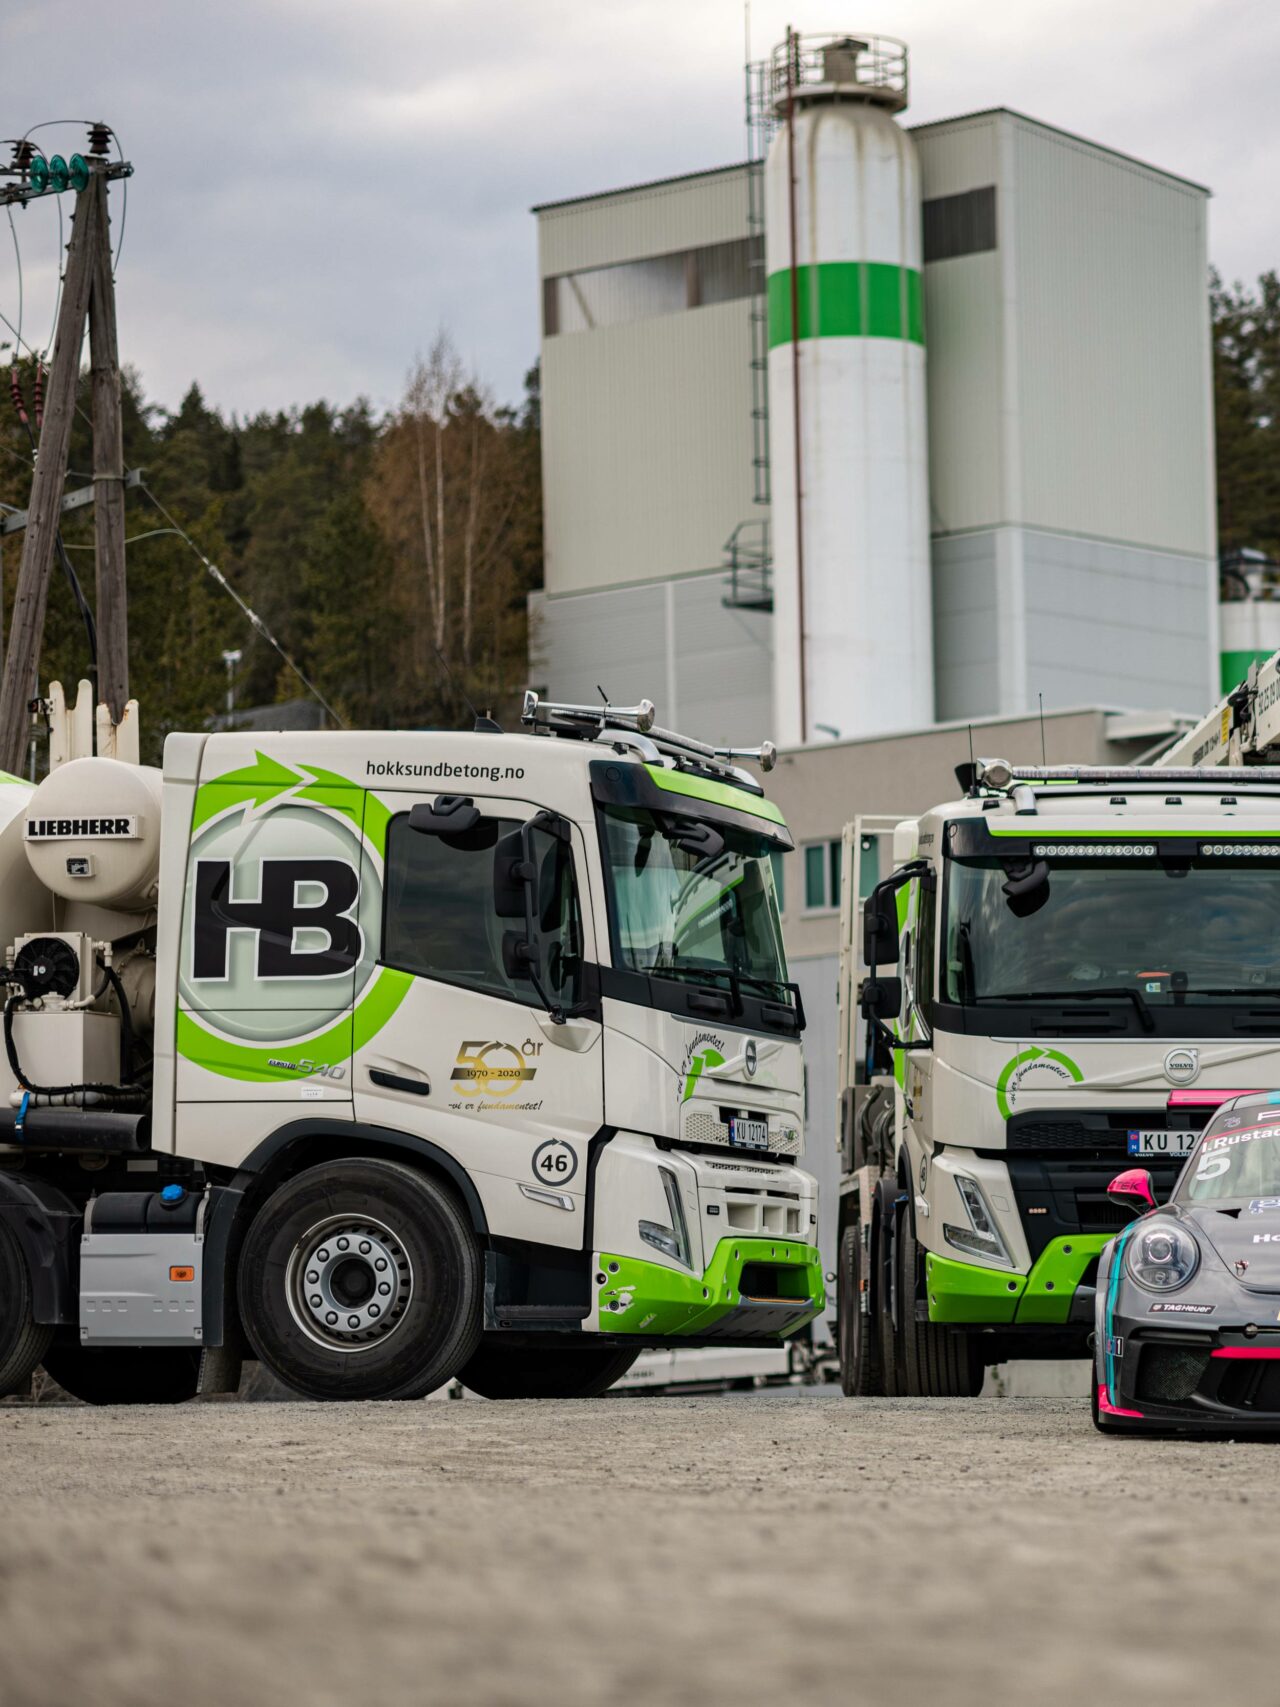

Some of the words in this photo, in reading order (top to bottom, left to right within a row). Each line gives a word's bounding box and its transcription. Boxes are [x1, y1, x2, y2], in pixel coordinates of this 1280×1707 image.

[366, 760, 525, 782] hokksundbetong.no
[28, 818, 130, 837] LIEBHERR
[193, 856, 364, 982] HB
[521, 1038, 543, 1056] år
[298, 1059, 346, 1080] 540
[467, 1070, 488, 1079] 1970
[477, 1100, 543, 1112] fundamentet!
[737, 1121, 745, 1139] KU
[749, 1123, 765, 1142] 12174
[1144, 1134, 1168, 1150] KU
[1177, 1134, 1201, 1150] 12
[541, 1154, 568, 1172] 46
[1196, 1147, 1231, 1181] 5
